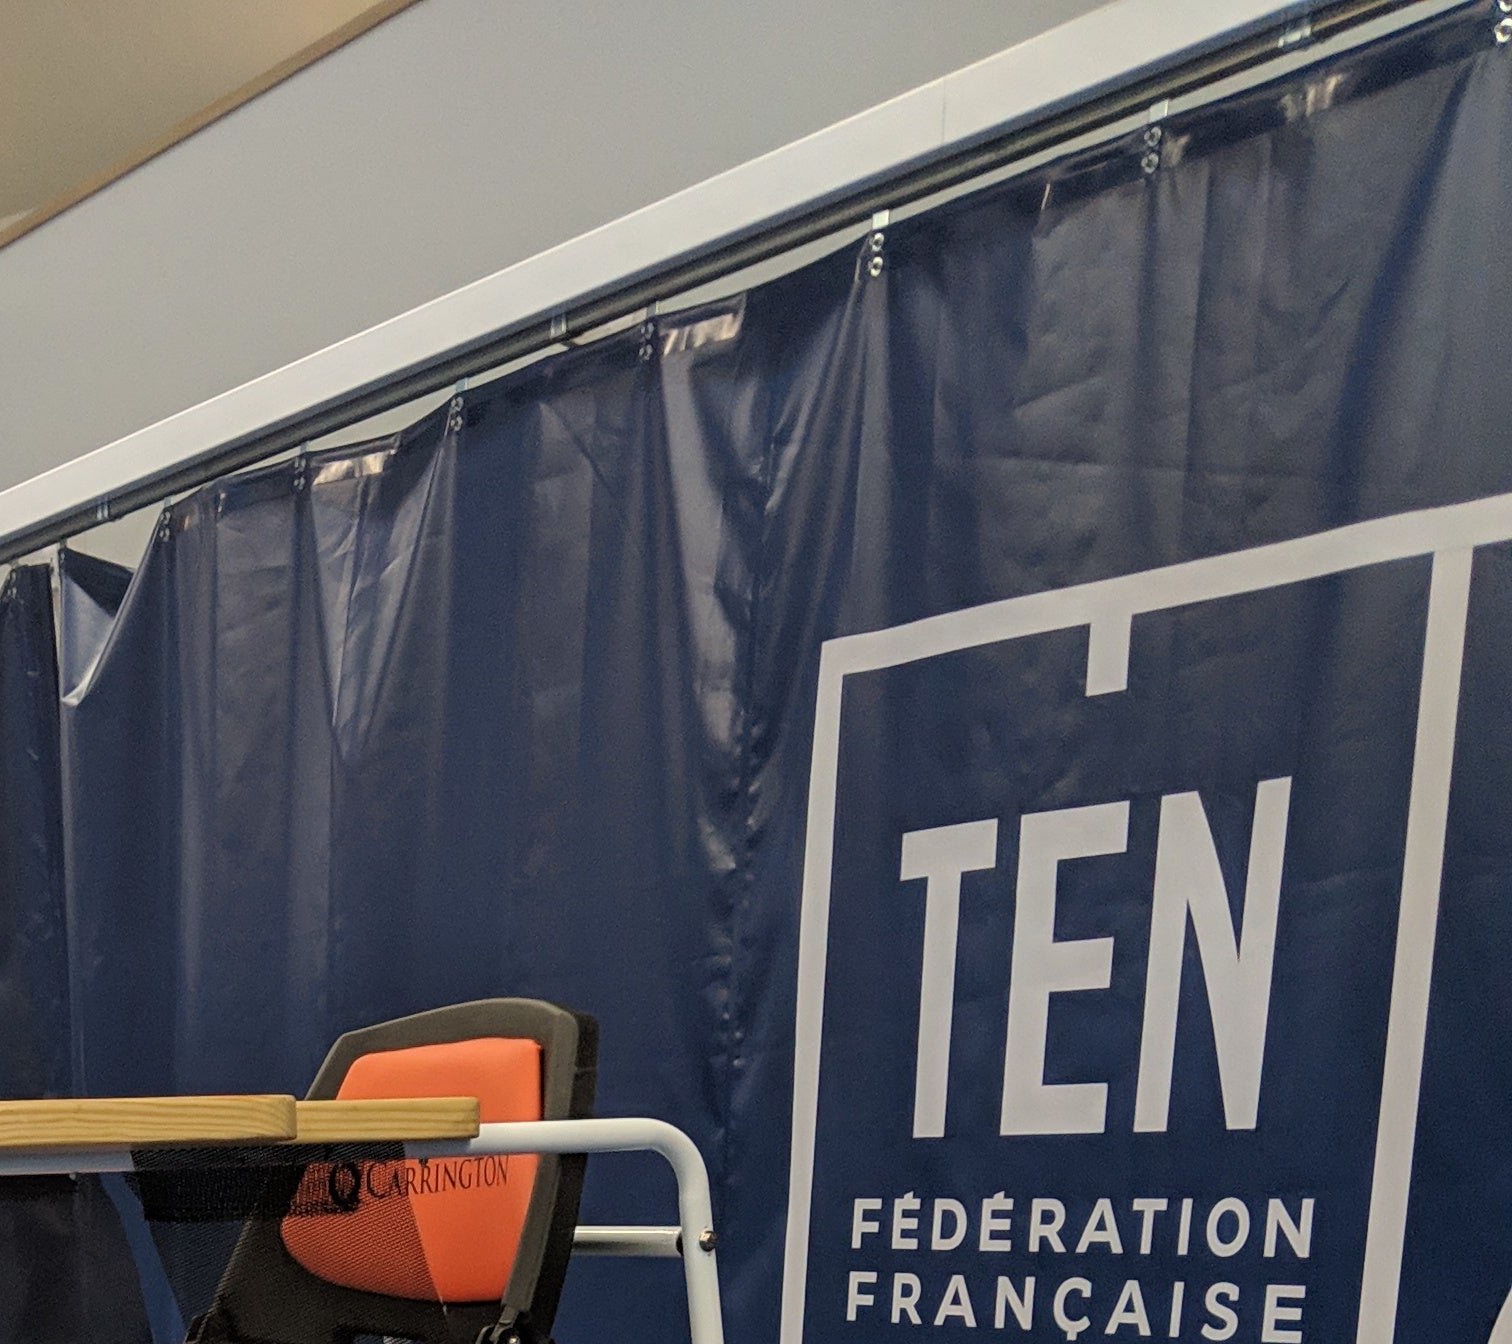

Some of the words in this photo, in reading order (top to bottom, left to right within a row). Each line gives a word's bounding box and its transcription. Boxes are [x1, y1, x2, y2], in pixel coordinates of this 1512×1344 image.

[899, 775, 1292, 1138] TEN
[851, 1192, 1314, 1258] FÉDÉRATION
[846, 1271, 1306, 1344] FRANÇAISE
